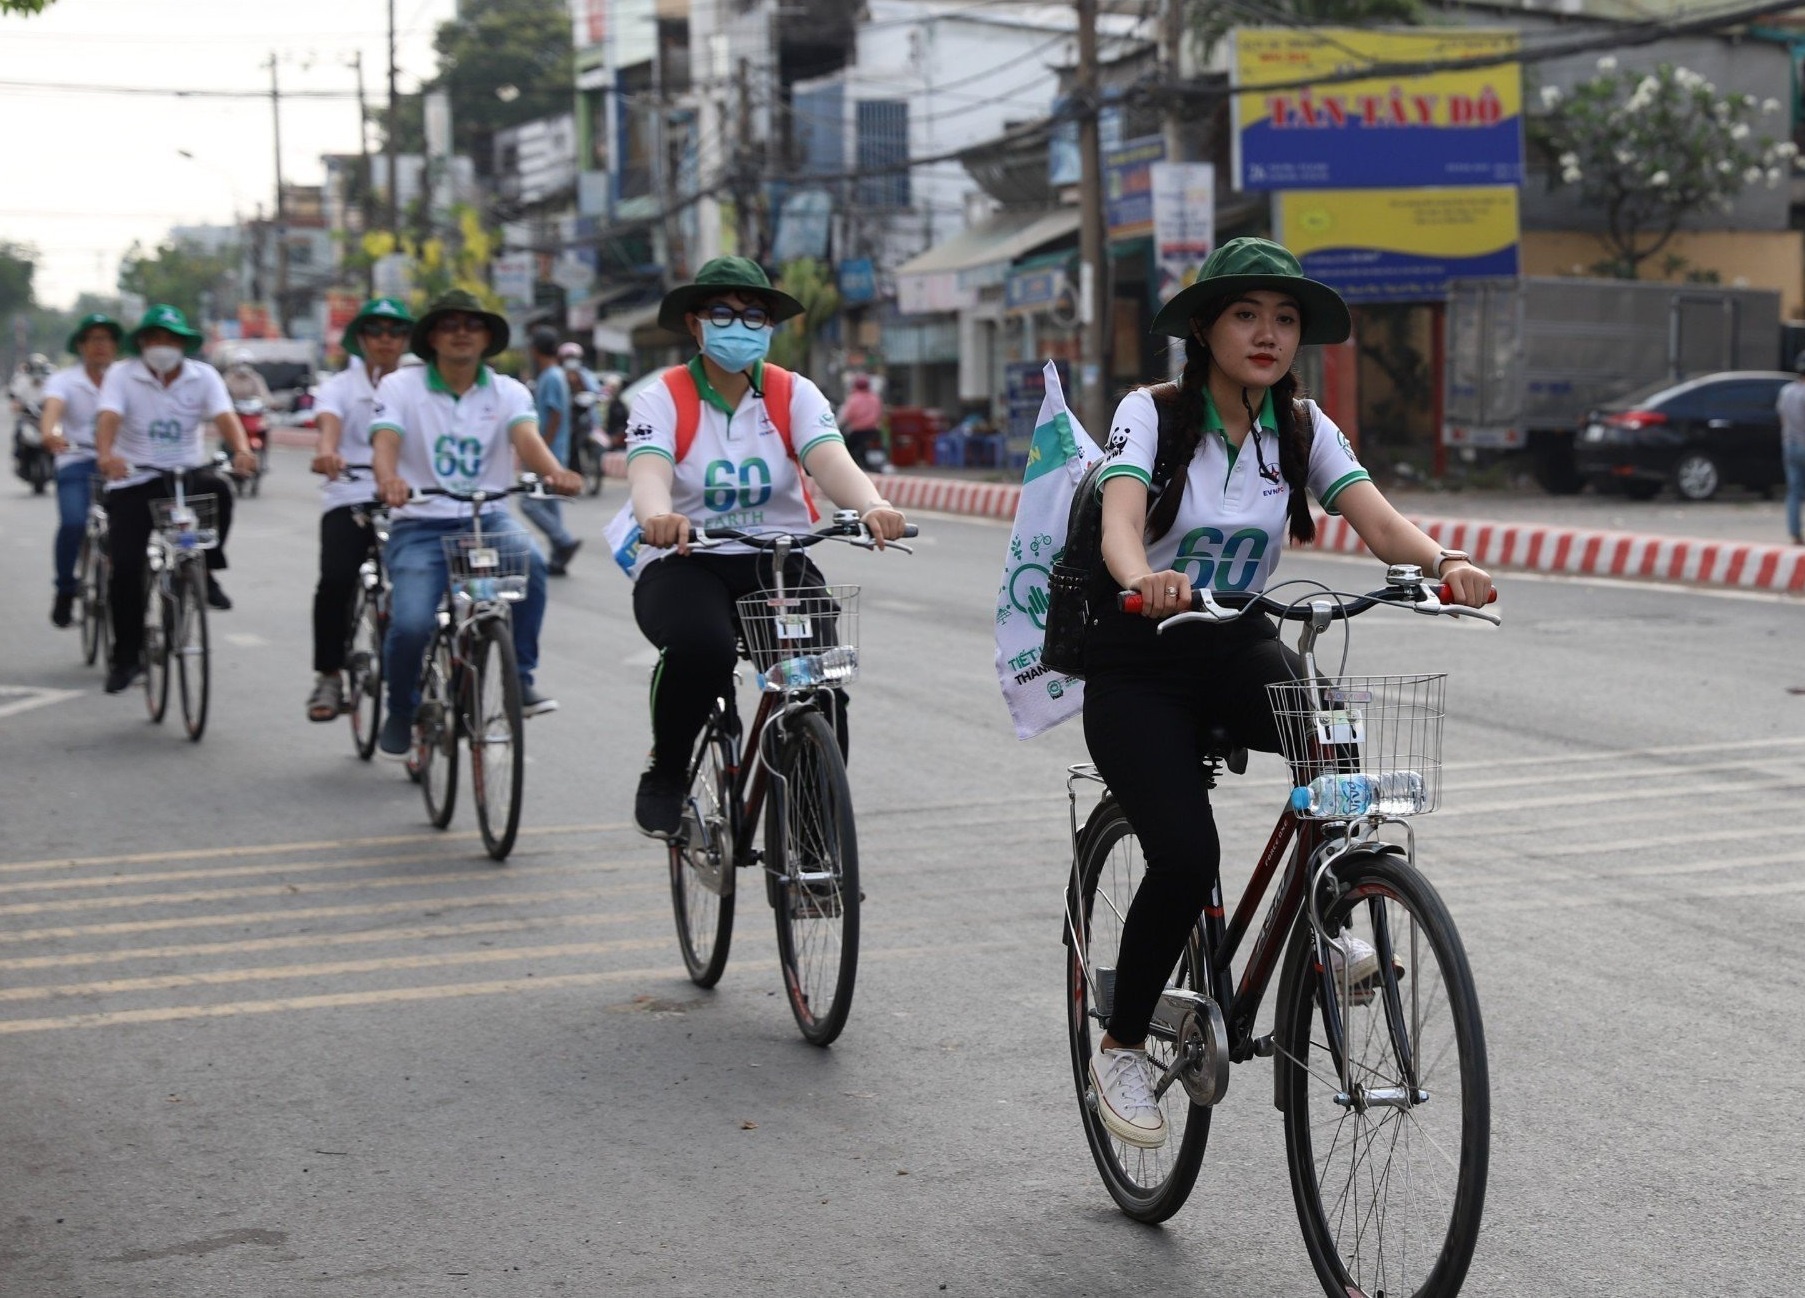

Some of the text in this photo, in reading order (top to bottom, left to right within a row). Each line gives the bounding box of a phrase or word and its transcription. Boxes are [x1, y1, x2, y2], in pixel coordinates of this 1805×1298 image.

[1357, 84, 1438, 128] TÂY
[435, 435, 482, 478] 60
[704, 457, 771, 512] 60
[704, 510, 764, 529] EARTH
[1171, 527, 1269, 591] 60
[1007, 649, 1037, 672] TIẾT
